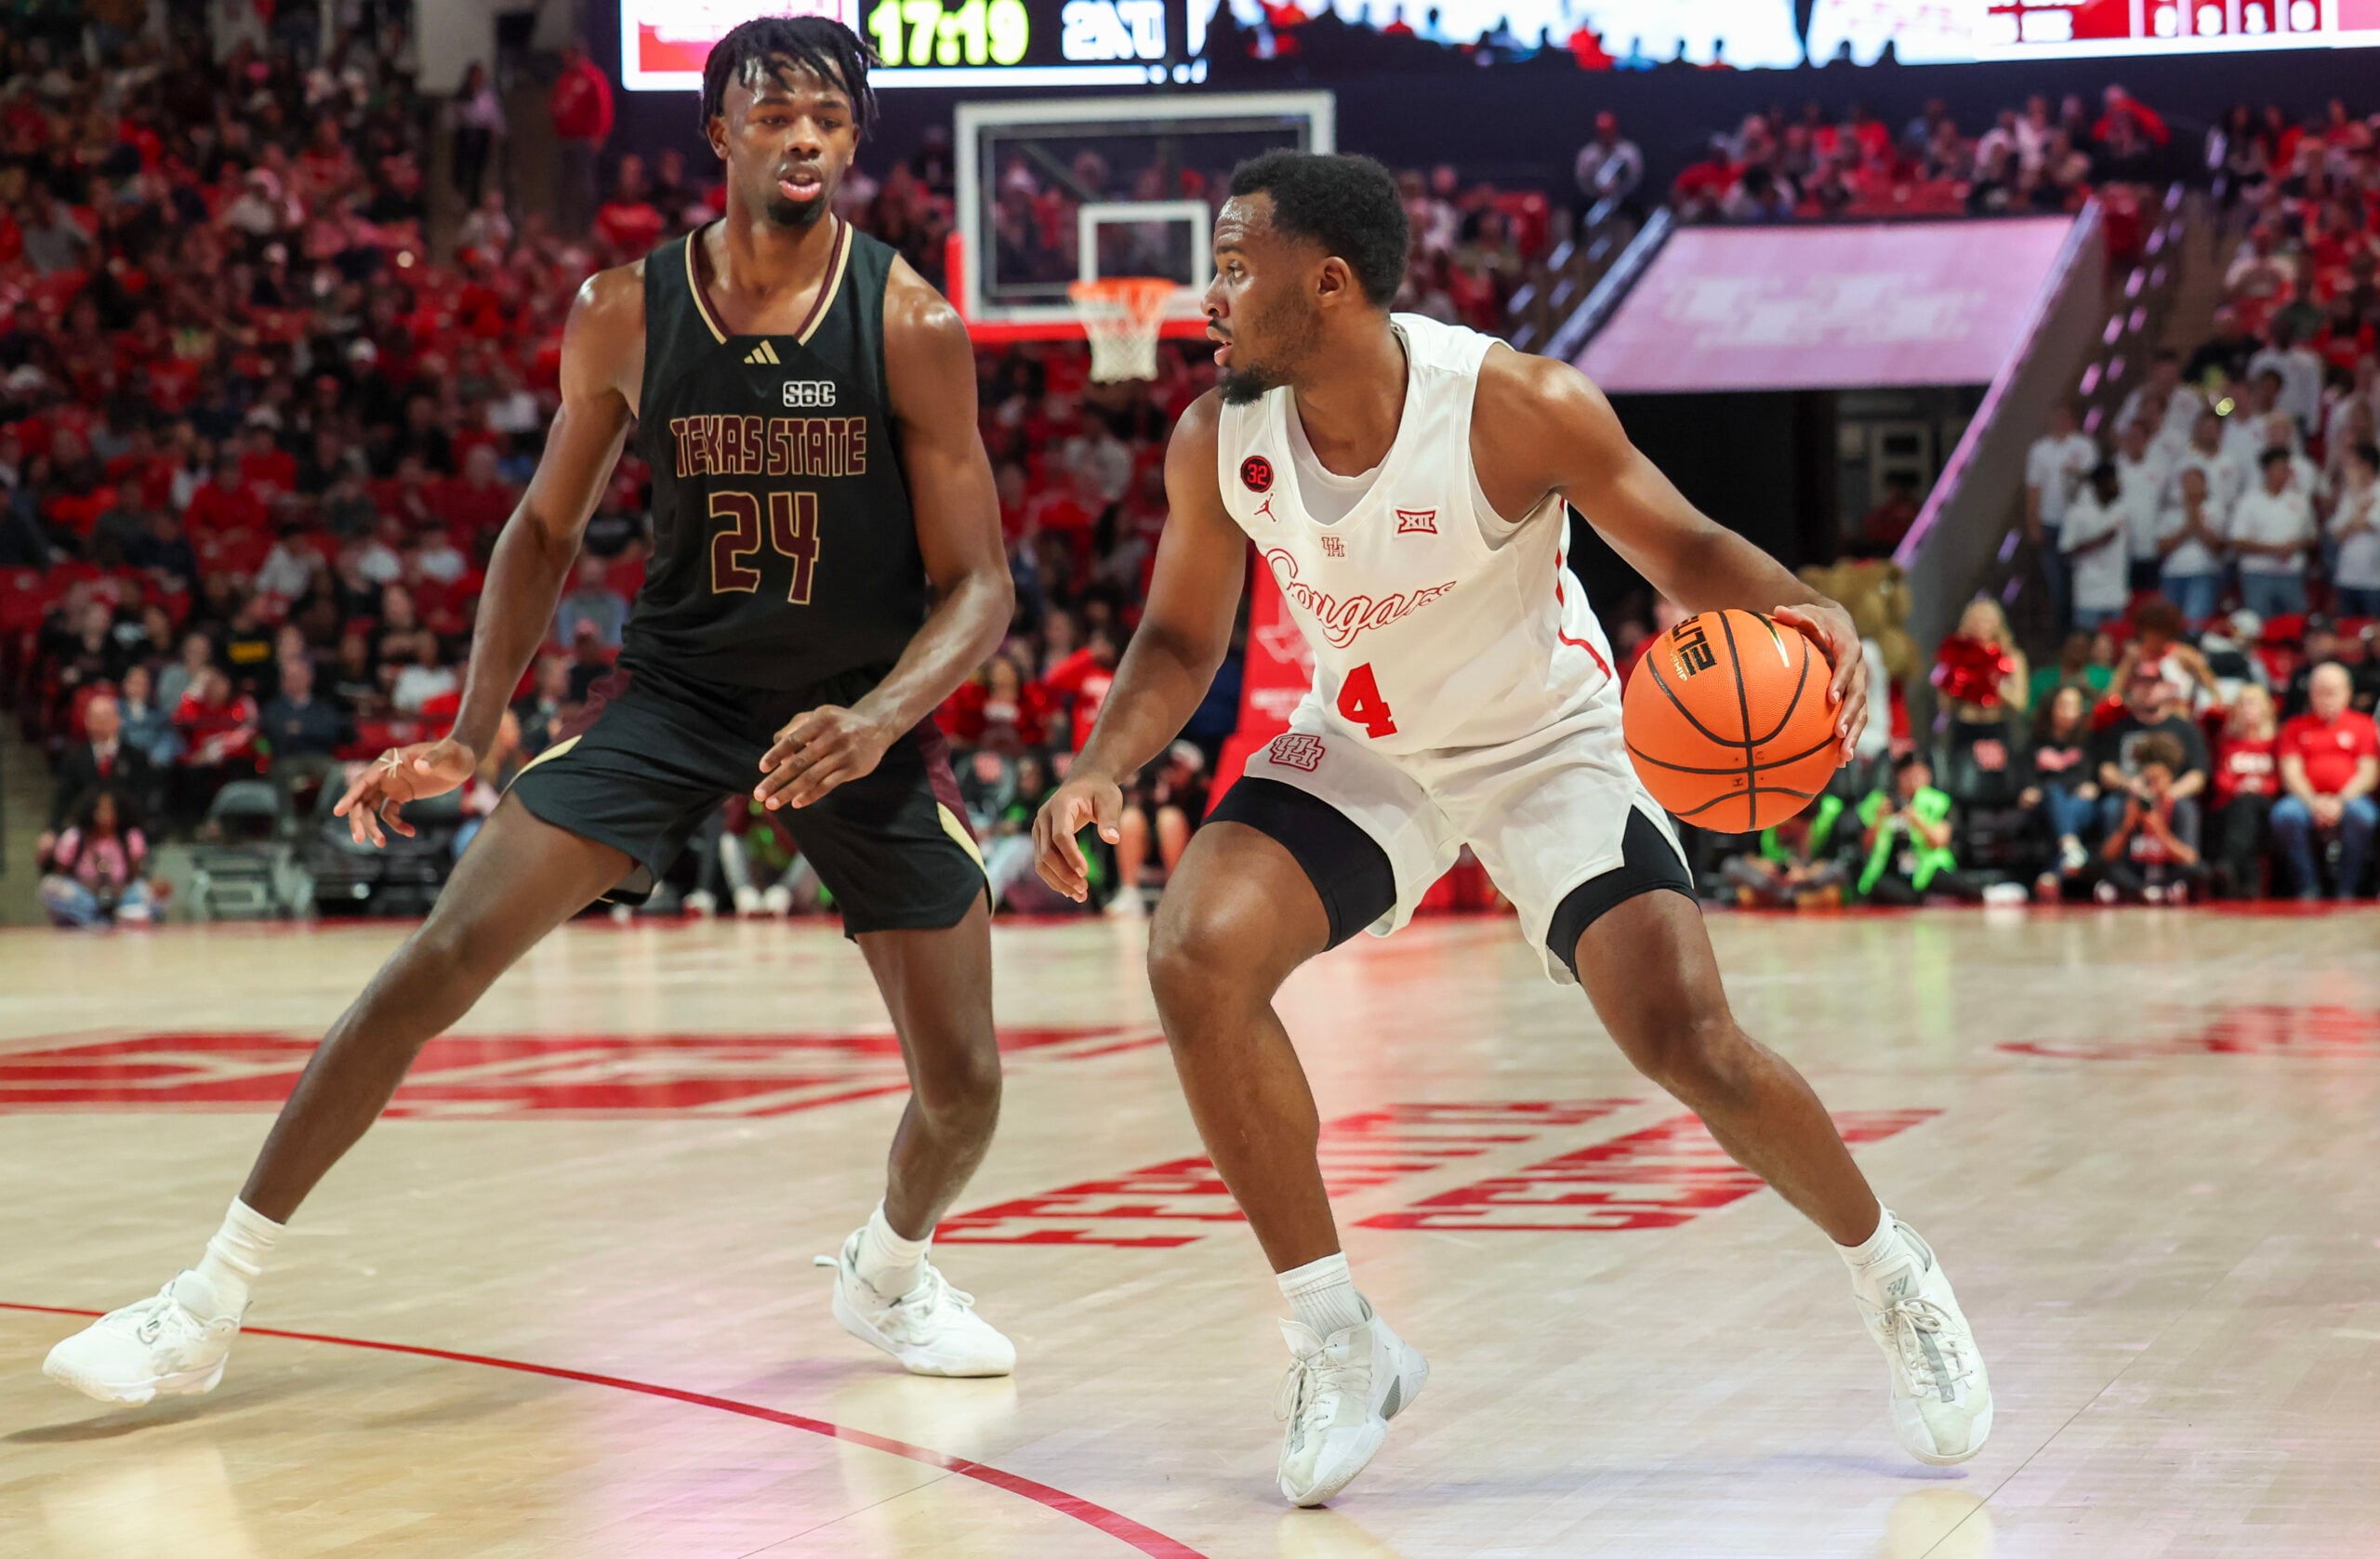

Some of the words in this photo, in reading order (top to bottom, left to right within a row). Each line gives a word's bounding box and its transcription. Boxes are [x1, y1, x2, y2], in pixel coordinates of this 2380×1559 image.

[868, 0, 1030, 67] 17:19
[783, 380, 836, 407] SBC
[669, 415, 764, 478] TEXAS
[767, 416, 867, 478] STATE
[1247, 462, 1268, 486] 32
[708, 491, 820, 605] 24
[1321, 536, 1345, 558] UH
[1266, 548, 1458, 649] Cougars
[1672, 615, 1717, 676] LITE
[1337, 662, 1398, 739] 4
[1269, 733, 1326, 773] UH
